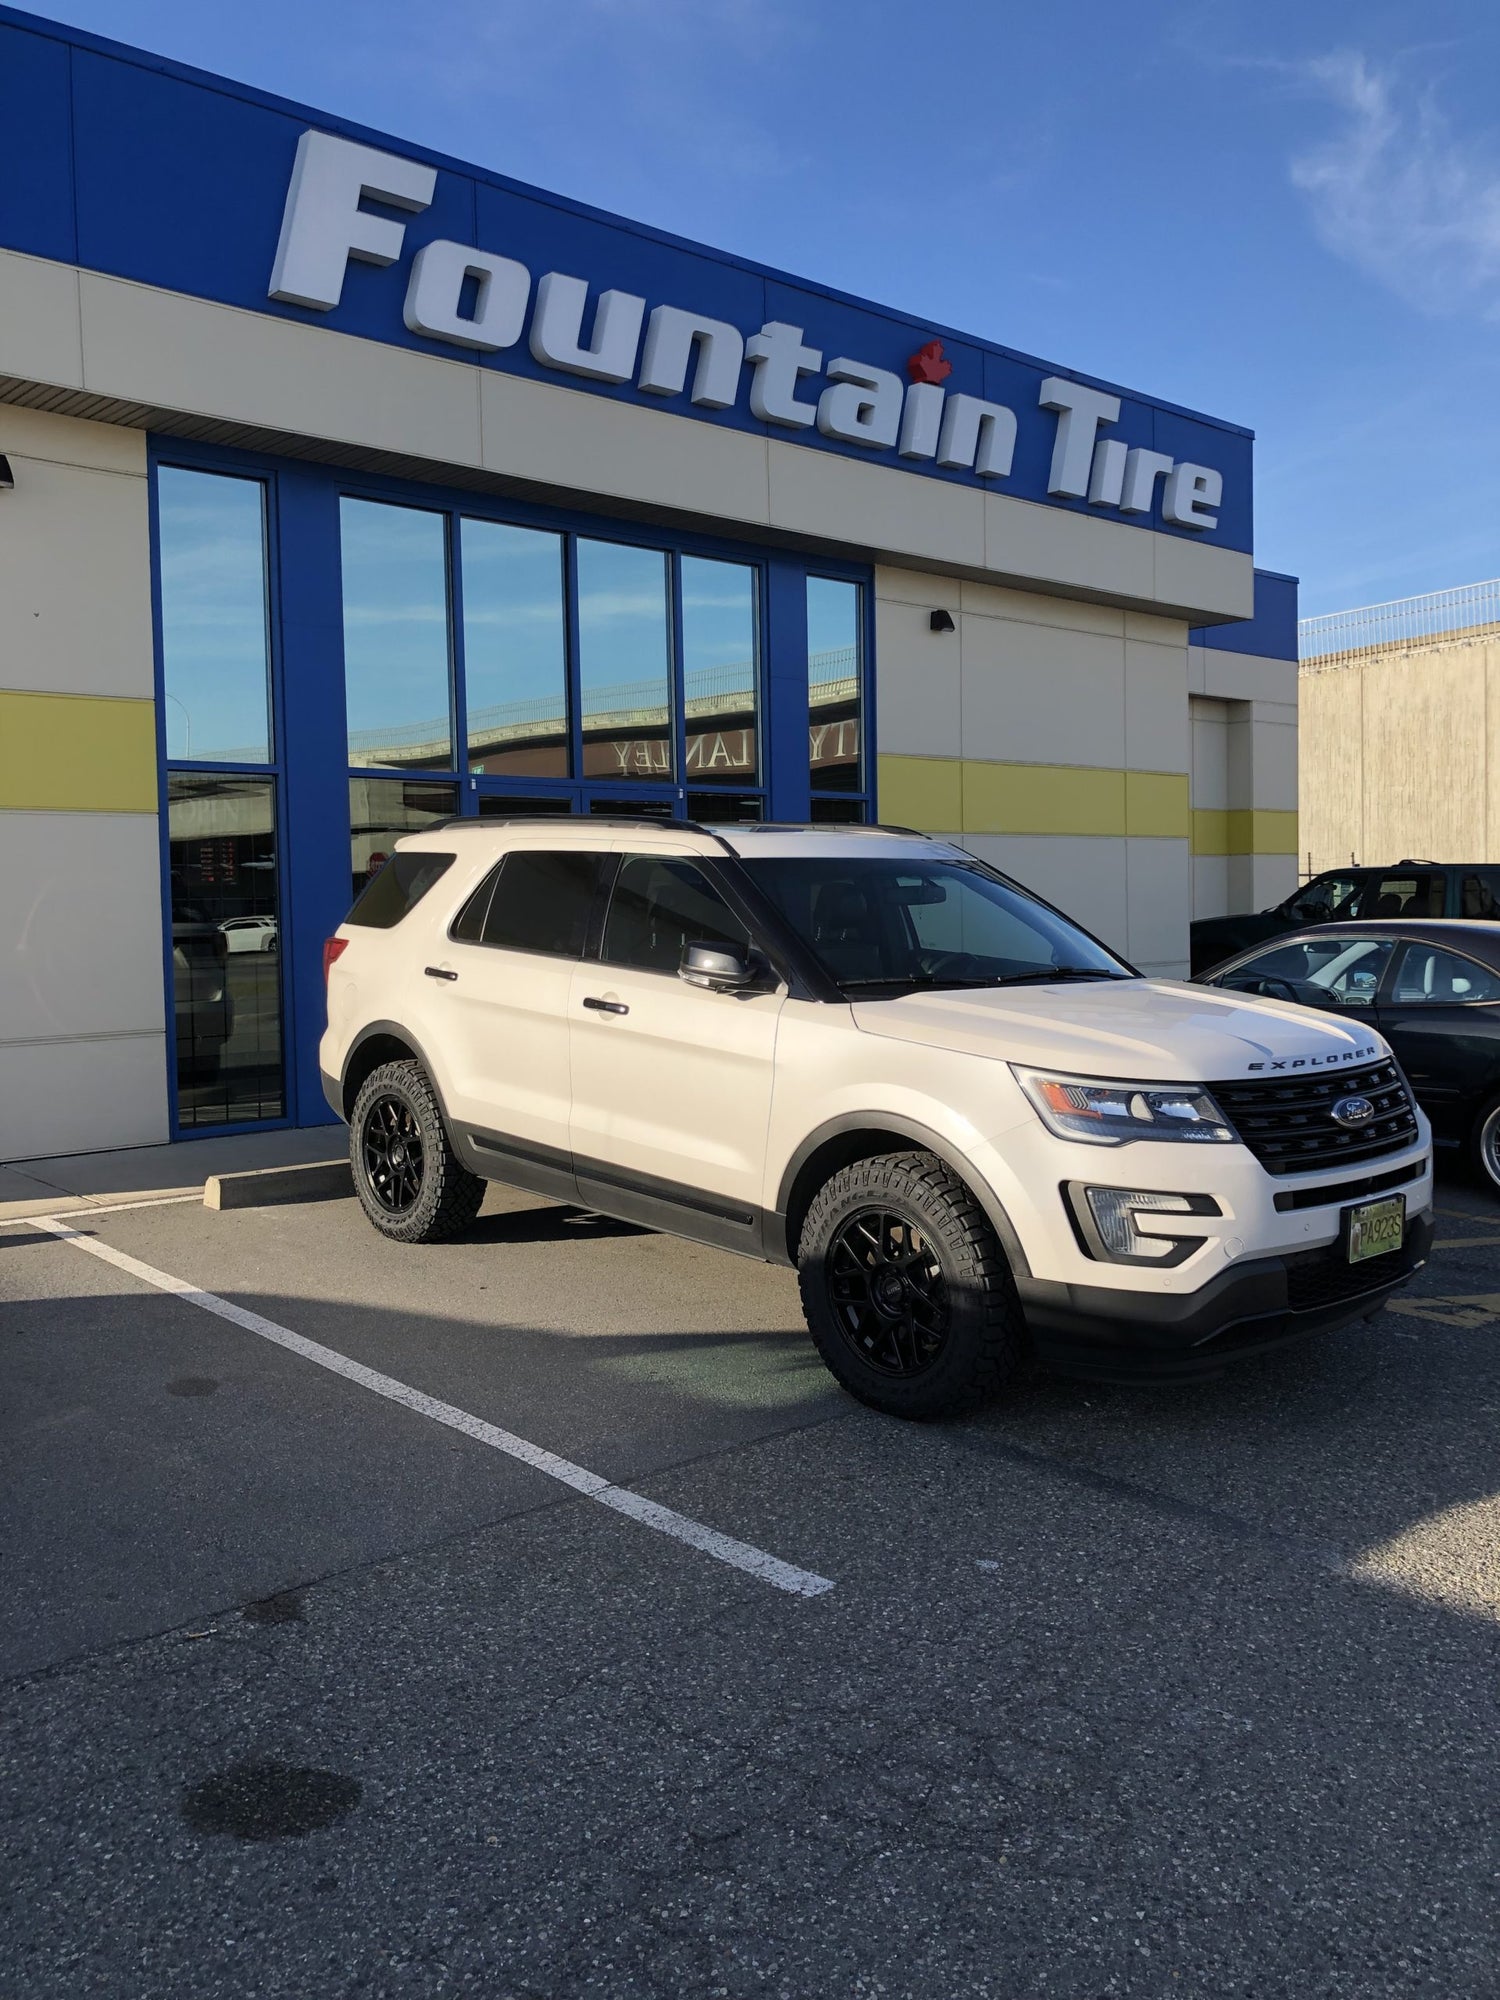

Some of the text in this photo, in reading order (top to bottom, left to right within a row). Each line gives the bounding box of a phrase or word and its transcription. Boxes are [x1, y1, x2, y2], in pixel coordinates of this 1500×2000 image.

[268, 129, 1223, 530] Fountain Tire
[1248, 1046, 1375, 1071] EXPLORER
